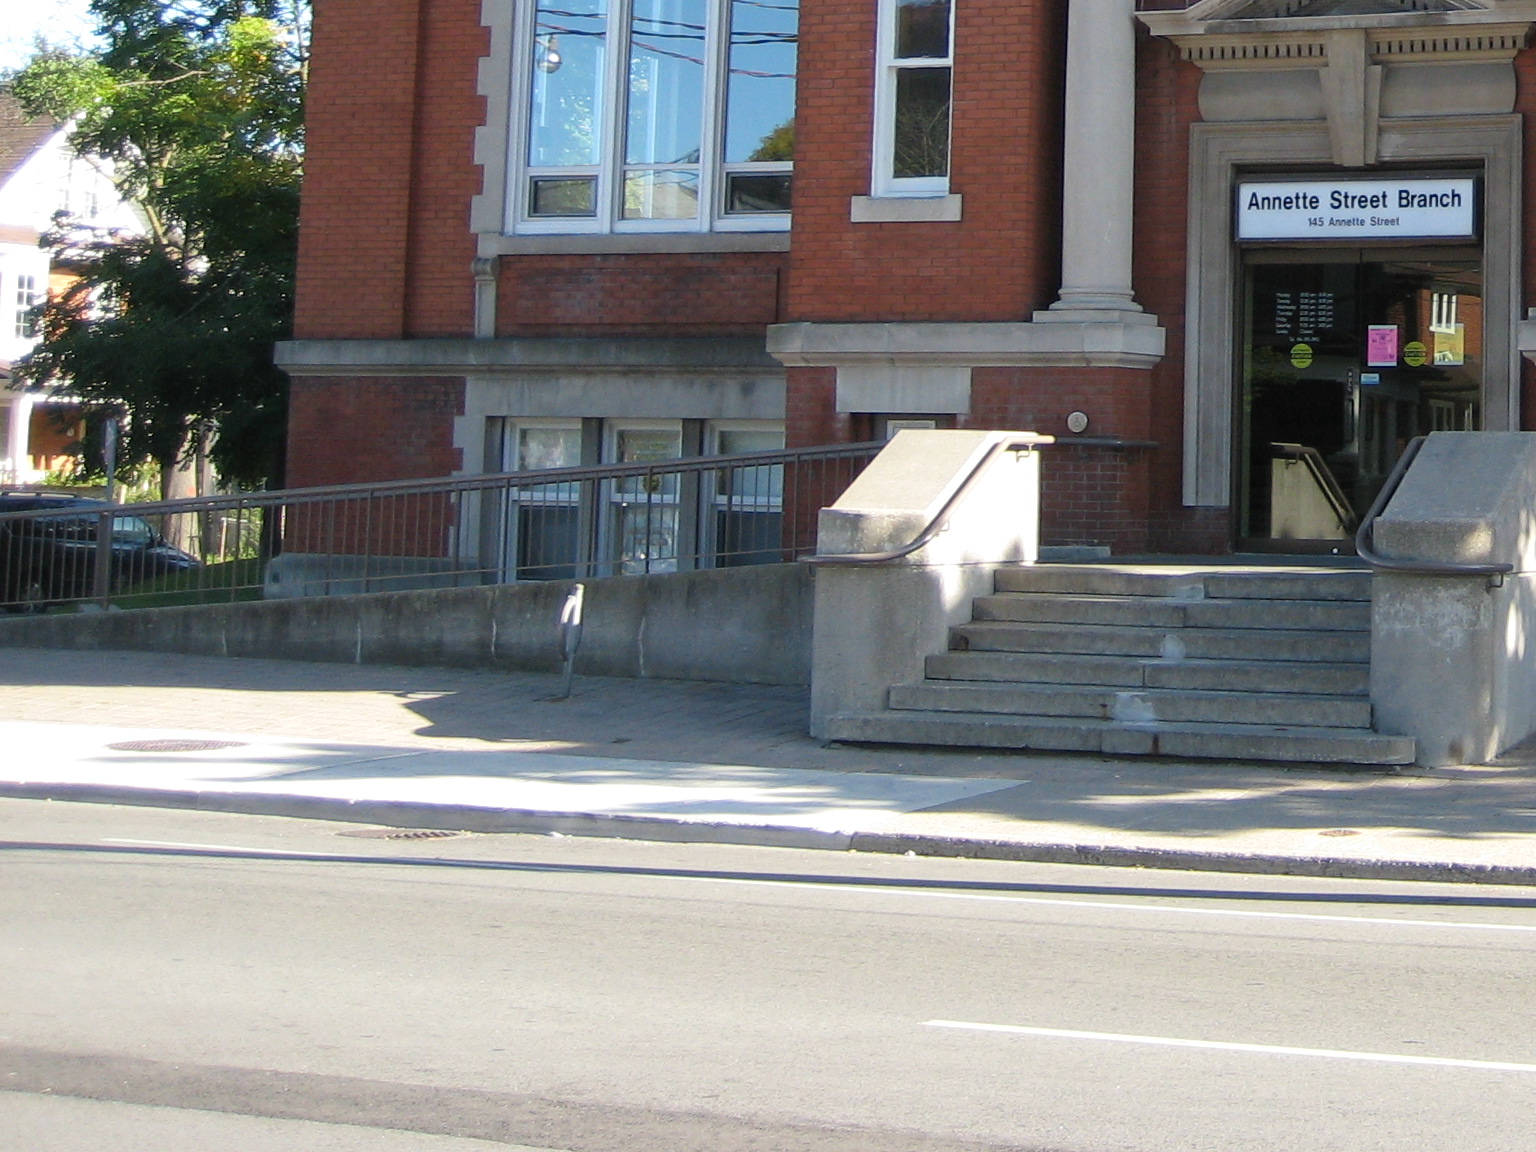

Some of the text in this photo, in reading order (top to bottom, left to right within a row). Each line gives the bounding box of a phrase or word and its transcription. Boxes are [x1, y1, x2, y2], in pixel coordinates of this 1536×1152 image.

[1247, 189, 1462, 210] Annette Street Branch
[1307, 216, 1400, 227] 145 Annette Street
